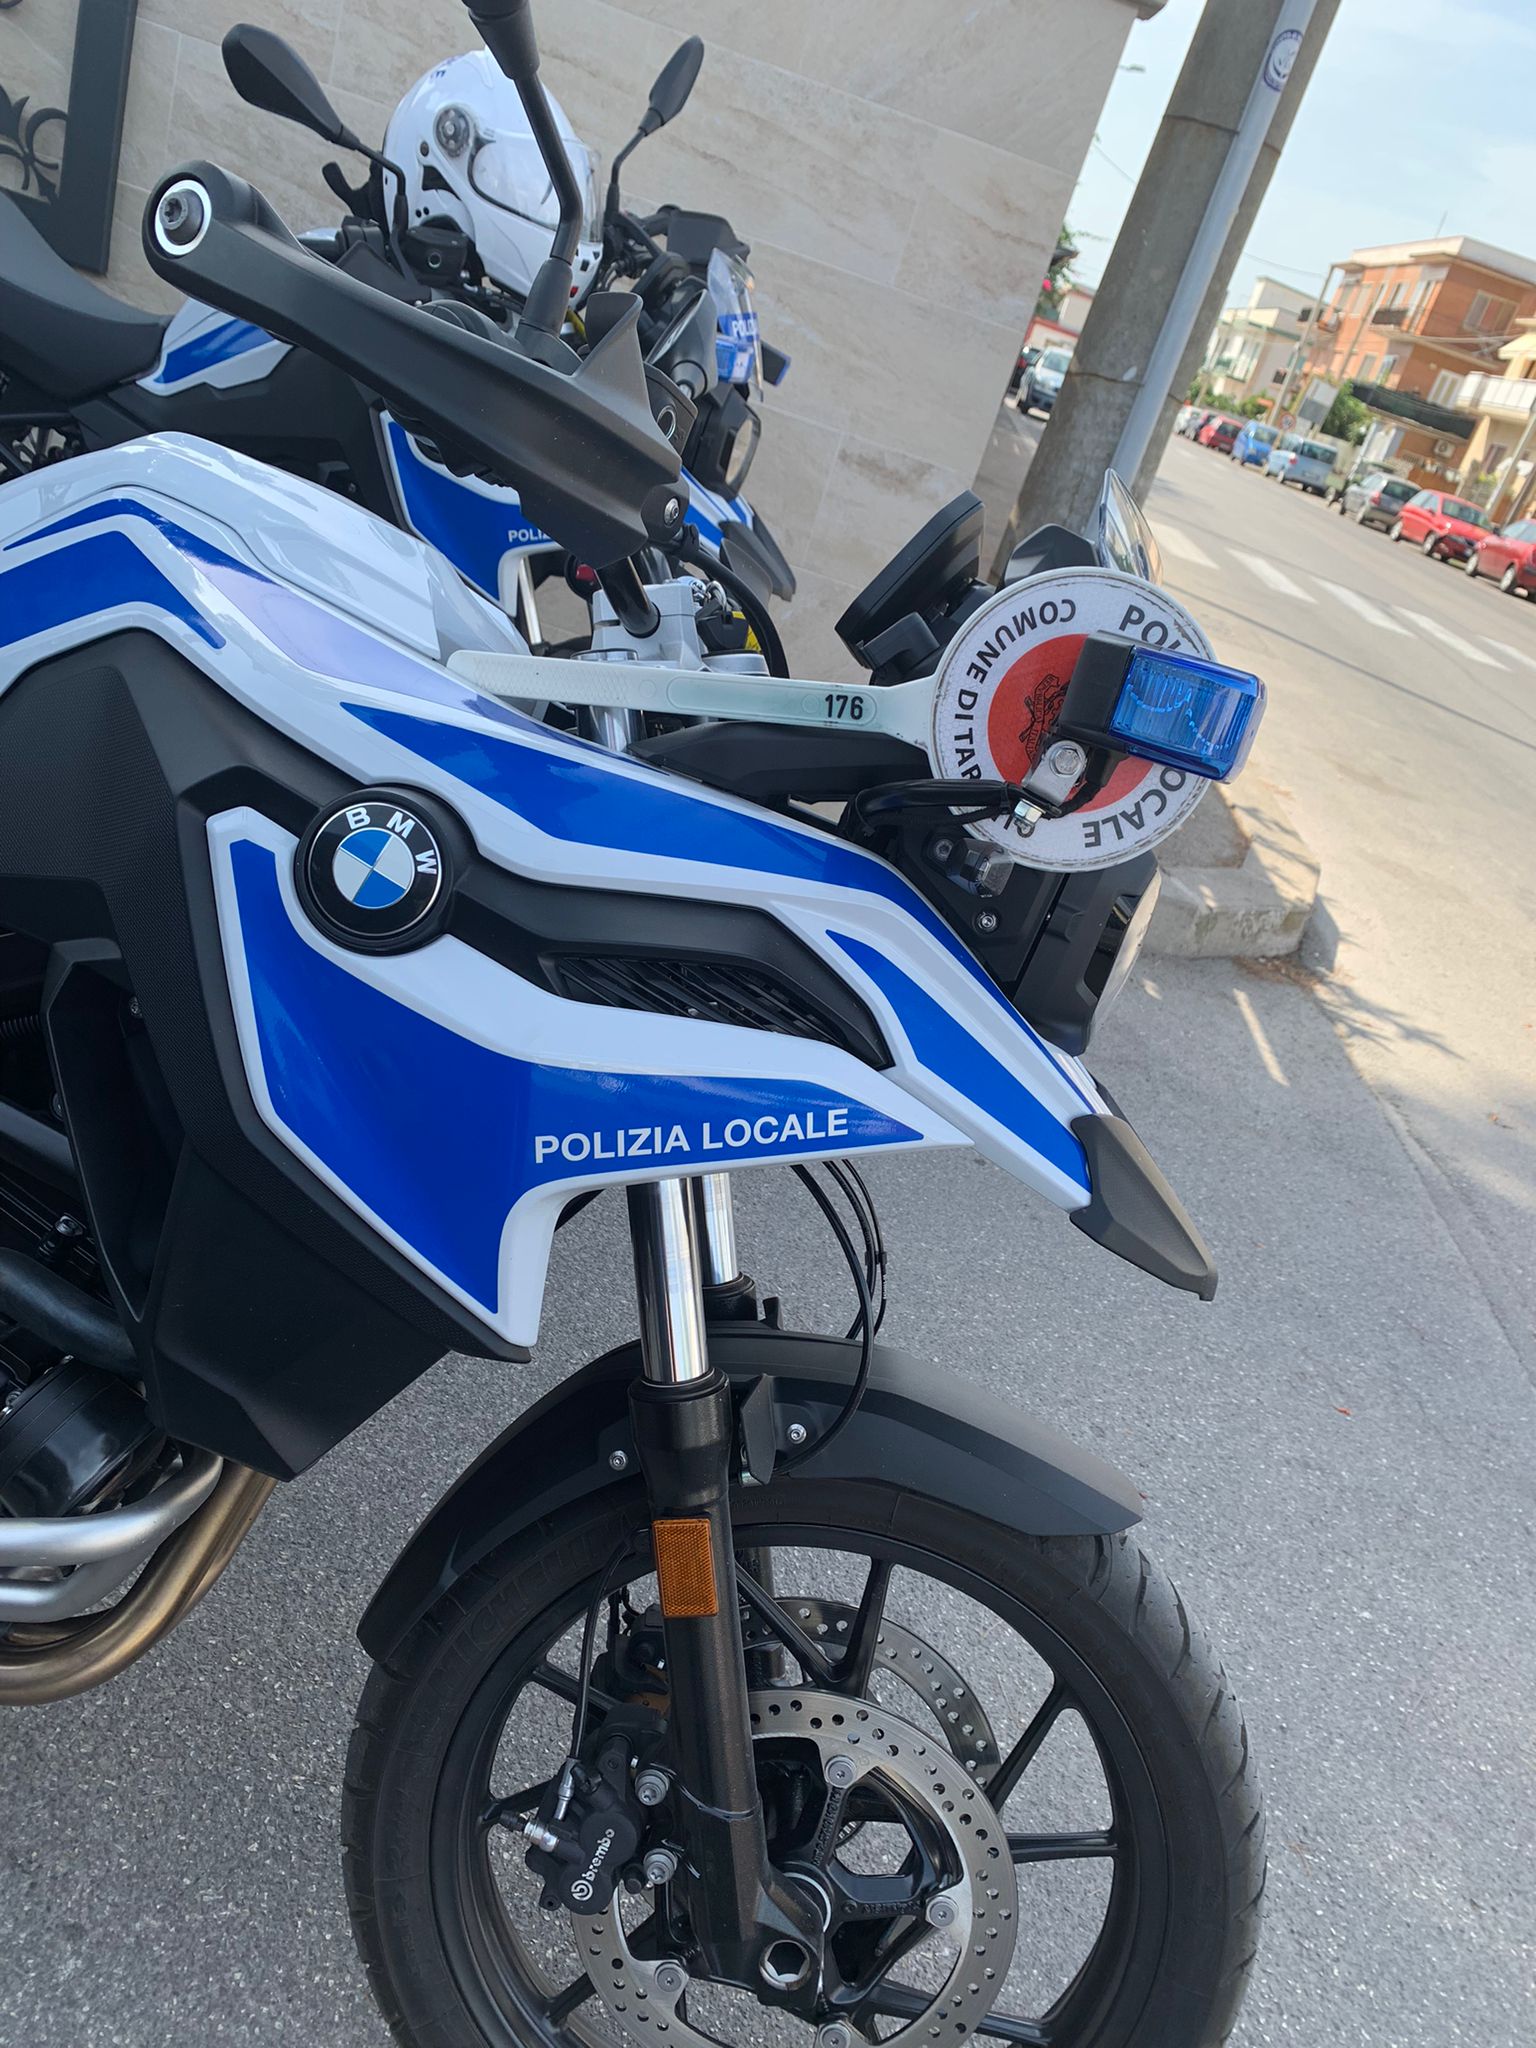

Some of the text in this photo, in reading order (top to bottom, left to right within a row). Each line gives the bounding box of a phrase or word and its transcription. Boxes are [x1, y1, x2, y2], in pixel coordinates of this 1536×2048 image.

[966, 599, 1076, 684] COMUNE
[825, 694, 864, 720] 176
[955, 689, 978, 720] DI
[1083, 766, 1186, 848] OCALE
[346, 807, 438, 875] BMW
[535, 1108, 849, 1163] POLIZIA LOCALE
[582, 1829, 615, 1881] brembo
